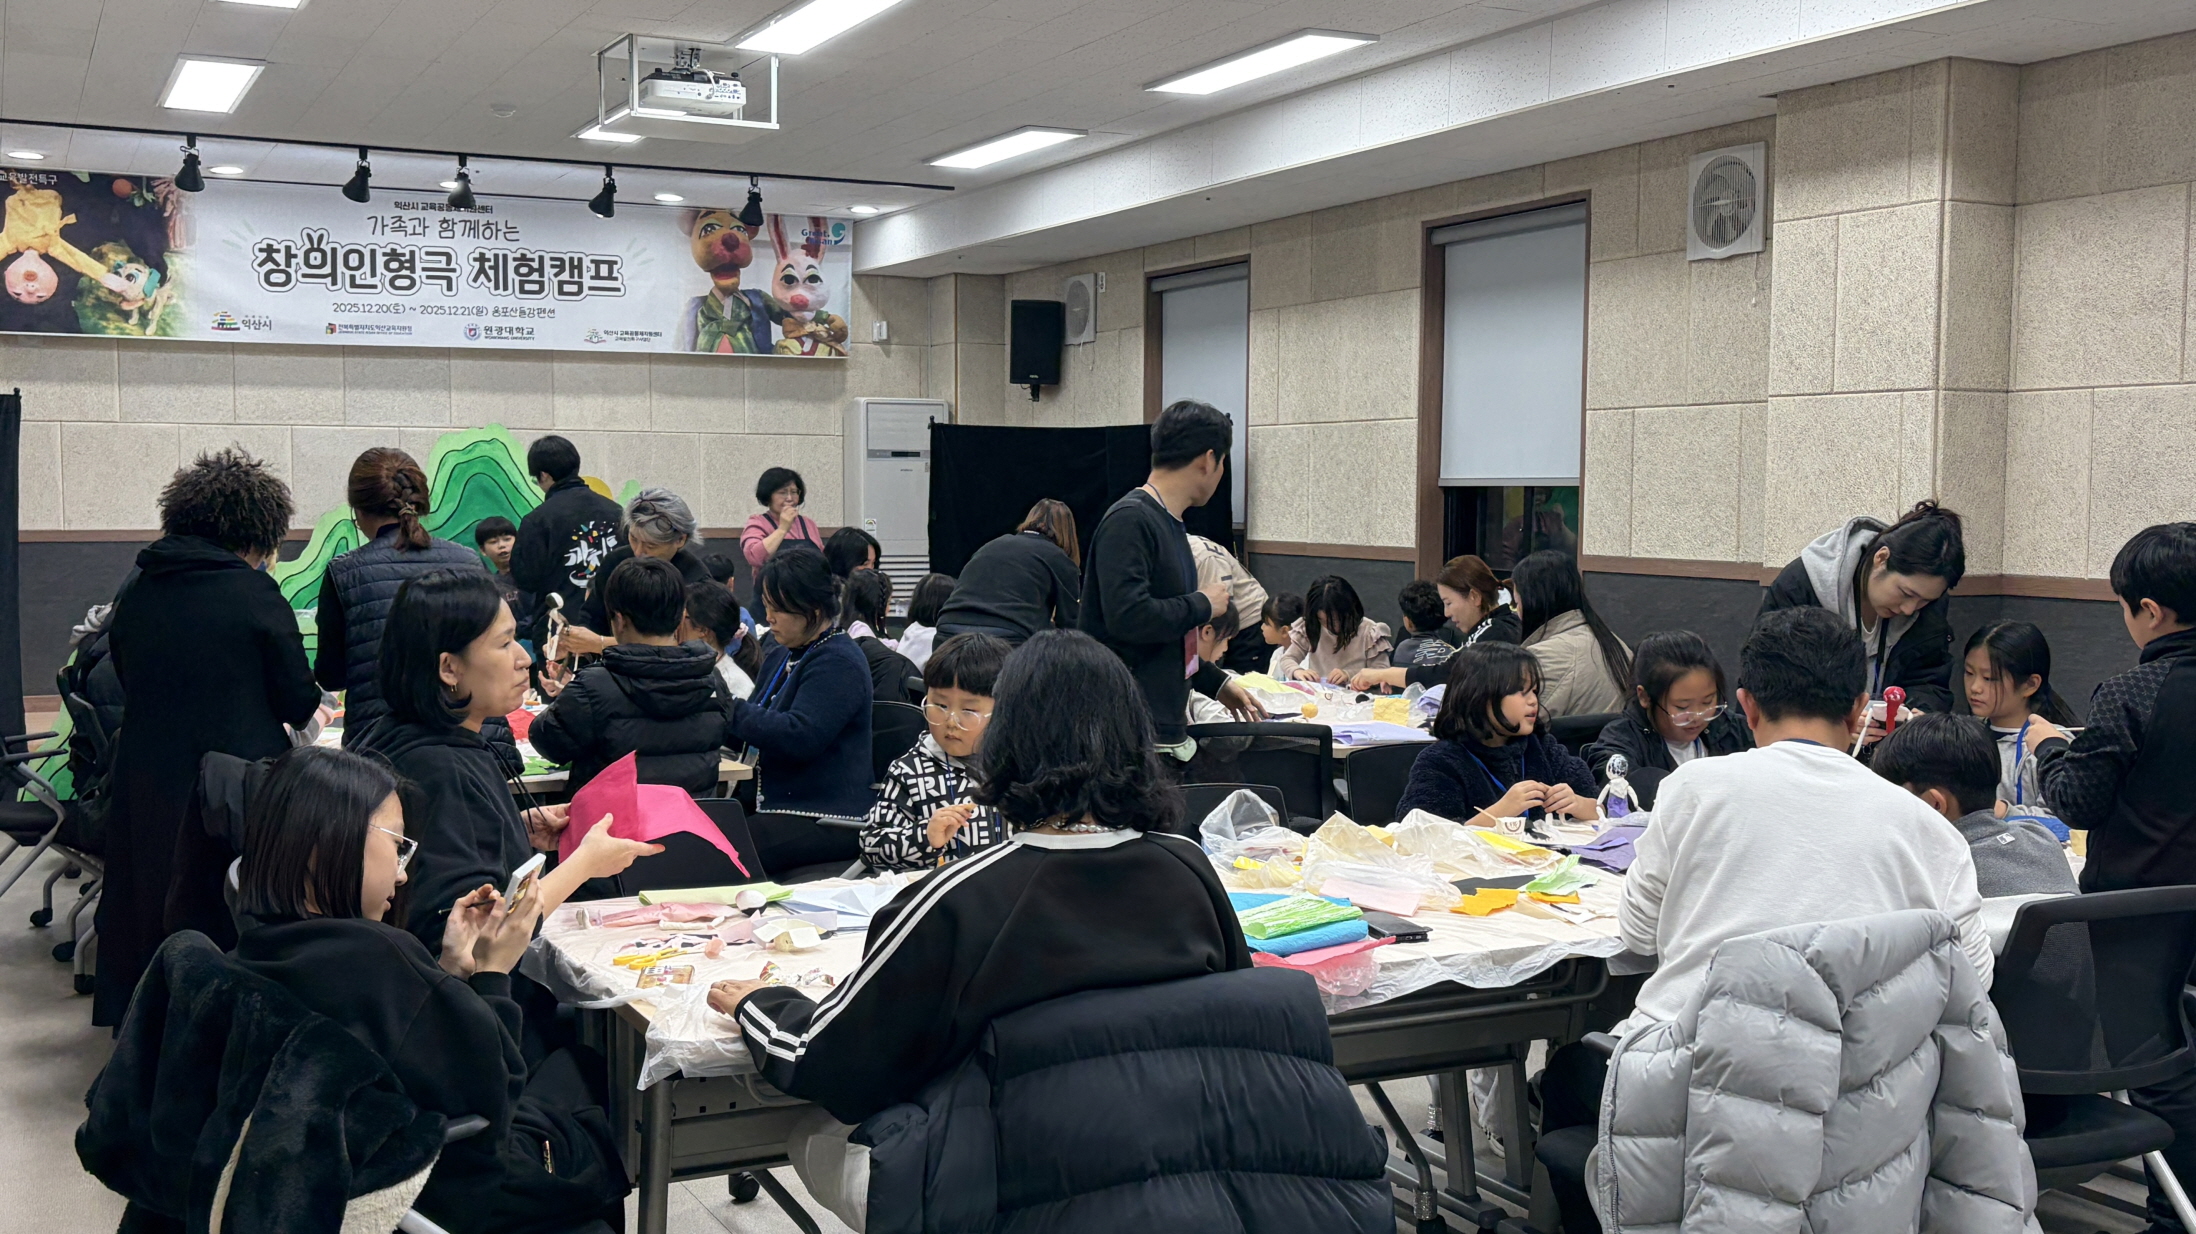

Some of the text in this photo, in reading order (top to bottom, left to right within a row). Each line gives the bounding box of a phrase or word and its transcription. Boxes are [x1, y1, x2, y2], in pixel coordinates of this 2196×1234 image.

[394, 201, 419, 210] 익산시
[367, 215, 520, 242] 가족과 함께하는
[256, 236, 622, 297] 창의인형극 체험캠프
[332, 303, 406, 314] 2025.12.20(토)
[420, 305, 489, 317] 2025.12.21(일)
[242, 319, 272, 331] 익산시
[484, 325, 535, 336] 원광대학교
